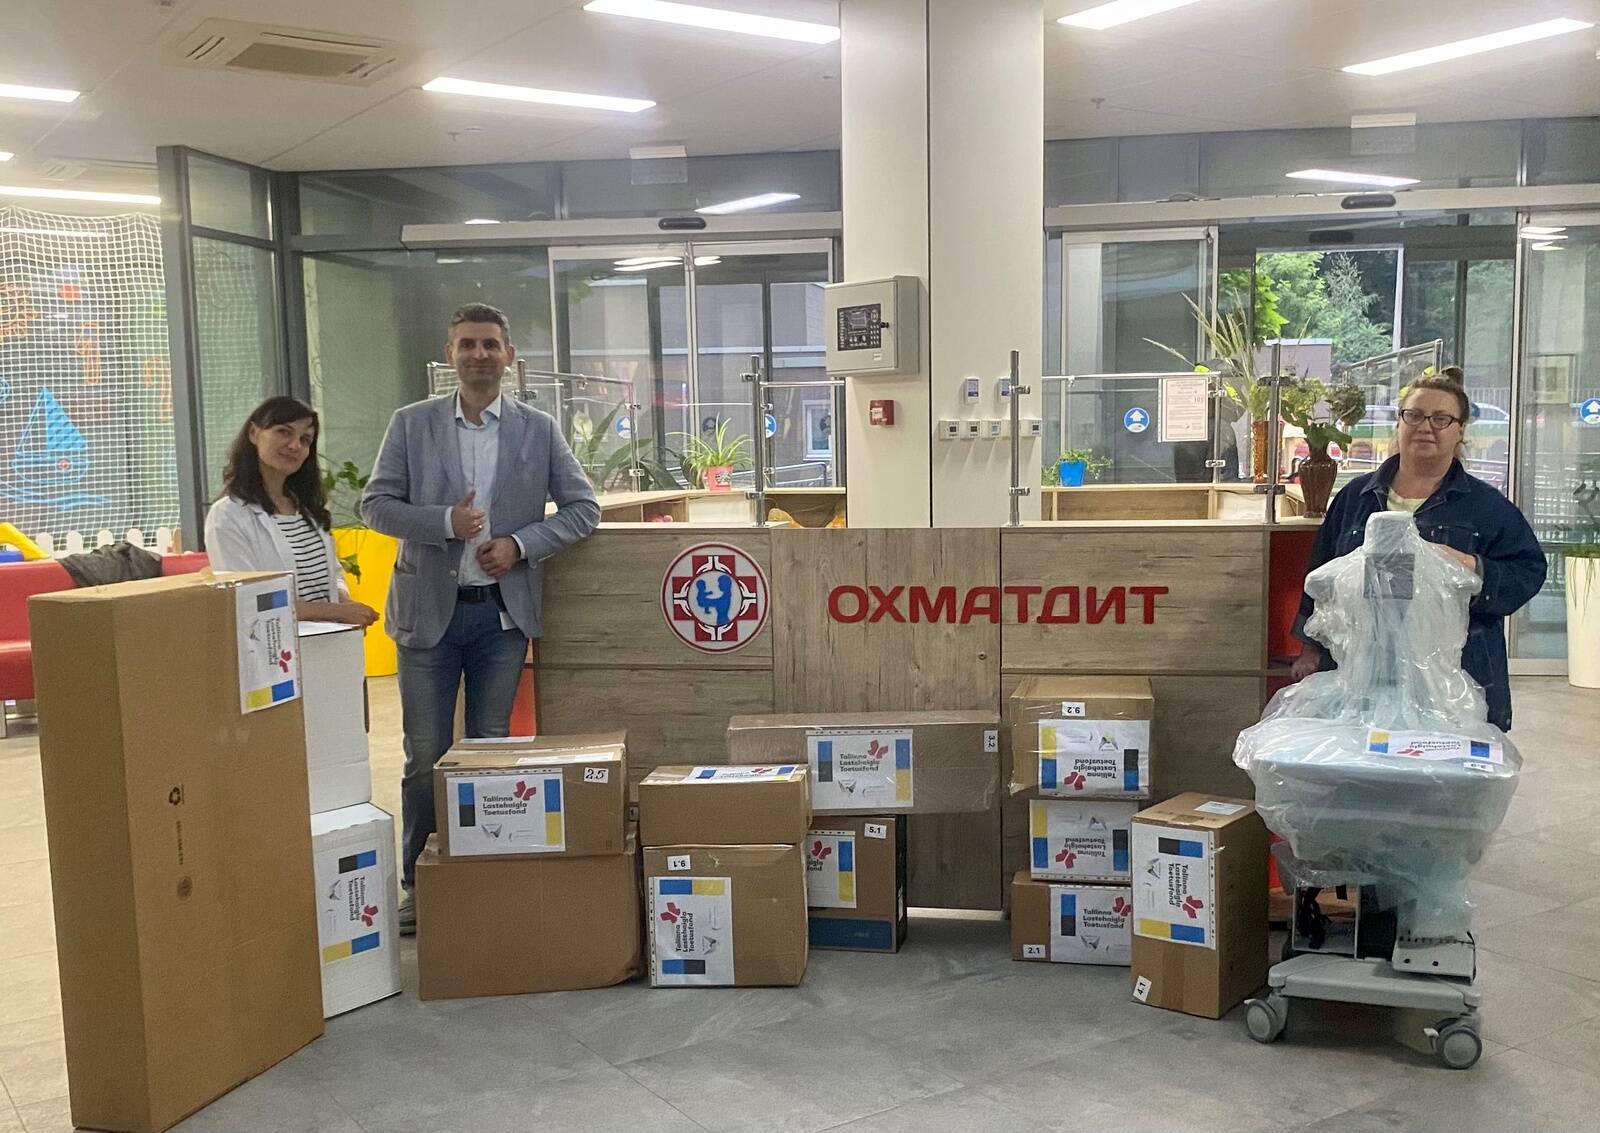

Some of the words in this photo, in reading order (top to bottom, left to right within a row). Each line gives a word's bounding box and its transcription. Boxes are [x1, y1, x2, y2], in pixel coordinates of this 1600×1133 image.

[828, 585, 1169, 624] ОХМАТДИТ
[1067, 706, 1080, 714] 9.2
[988, 735, 996, 748] 3.2
[482, 802, 528, 810] Lastehaigla
[483, 808, 527, 816] Toetusfond
[869, 826, 881, 834] 5.1
[673, 860, 686, 868] 9.1
[1083, 908, 1112, 916] Tallinna
[1083, 915, 1125, 923] Lastehaigla
[1083, 921, 1124, 929] Toetusfond
[1137, 981, 1147, 995] 4.1
